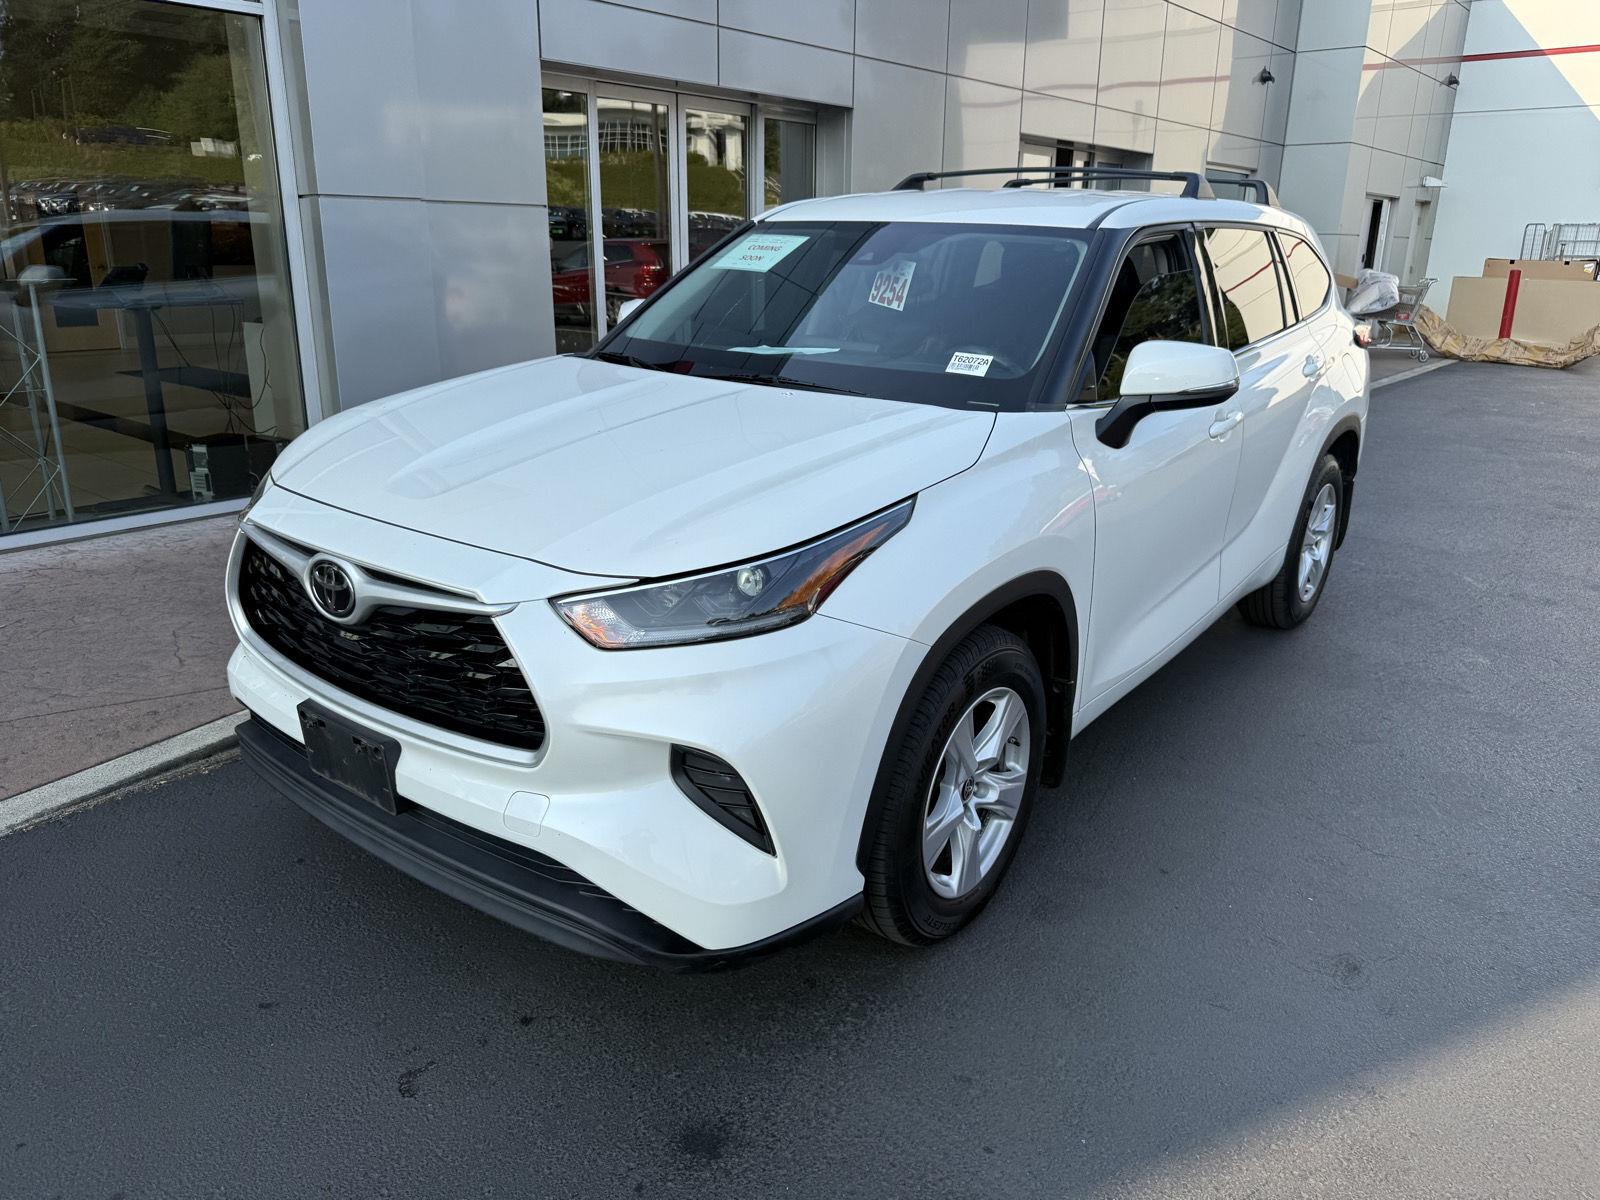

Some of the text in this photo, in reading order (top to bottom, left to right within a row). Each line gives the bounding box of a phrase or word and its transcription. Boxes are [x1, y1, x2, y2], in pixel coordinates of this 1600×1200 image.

[747, 244, 783, 252] COMING
[740, 254, 765, 262] SOON
[871, 272, 908, 308] 9254
[953, 355, 989, 366] T62072A
